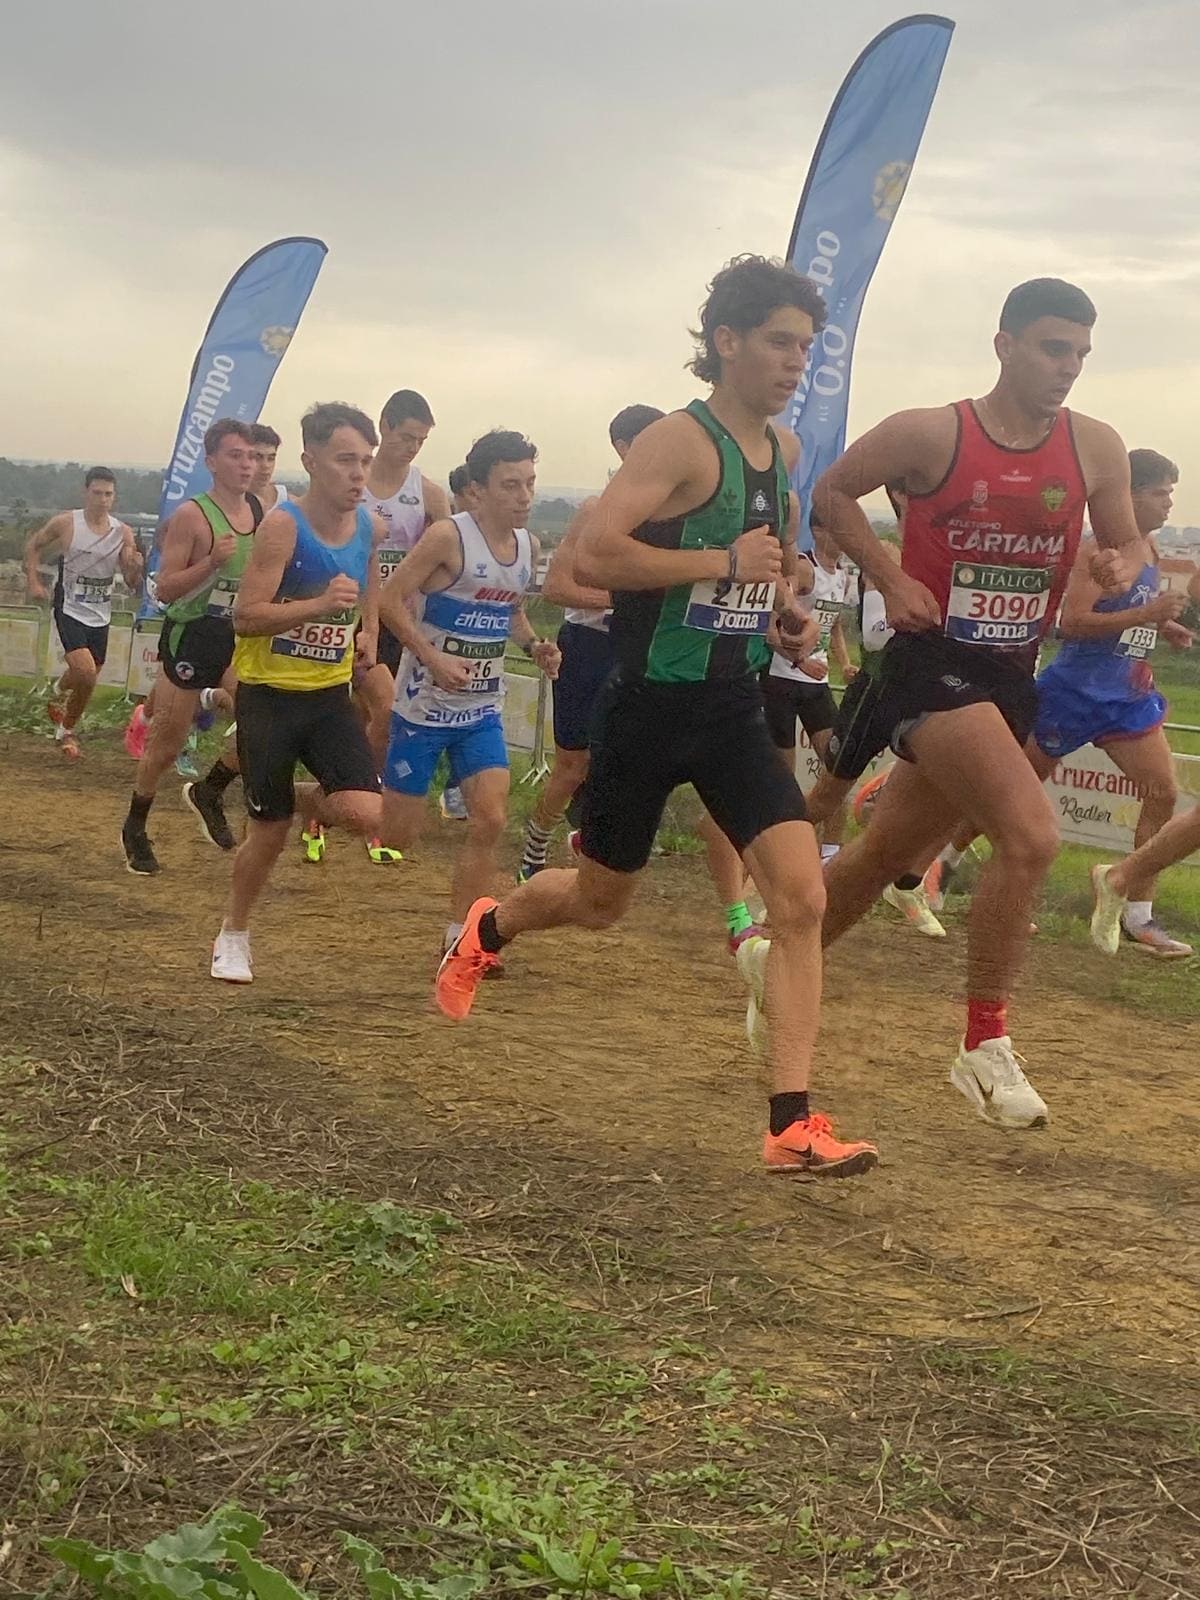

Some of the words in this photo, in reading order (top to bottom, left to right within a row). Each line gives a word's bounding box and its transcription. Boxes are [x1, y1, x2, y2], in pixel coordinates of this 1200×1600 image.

[162, 354, 235, 500] Cruzcampo
[711, 580, 770, 609] 2144
[968, 593, 1040, 621] 3090
[713, 611, 758, 629] Joma
[972, 622, 1028, 639] Joma
[289, 625, 347, 647] 3685
[1130, 629, 1154, 647] 1333
[290, 644, 337, 660] Joma
[1059, 795, 1112, 824] Radler
